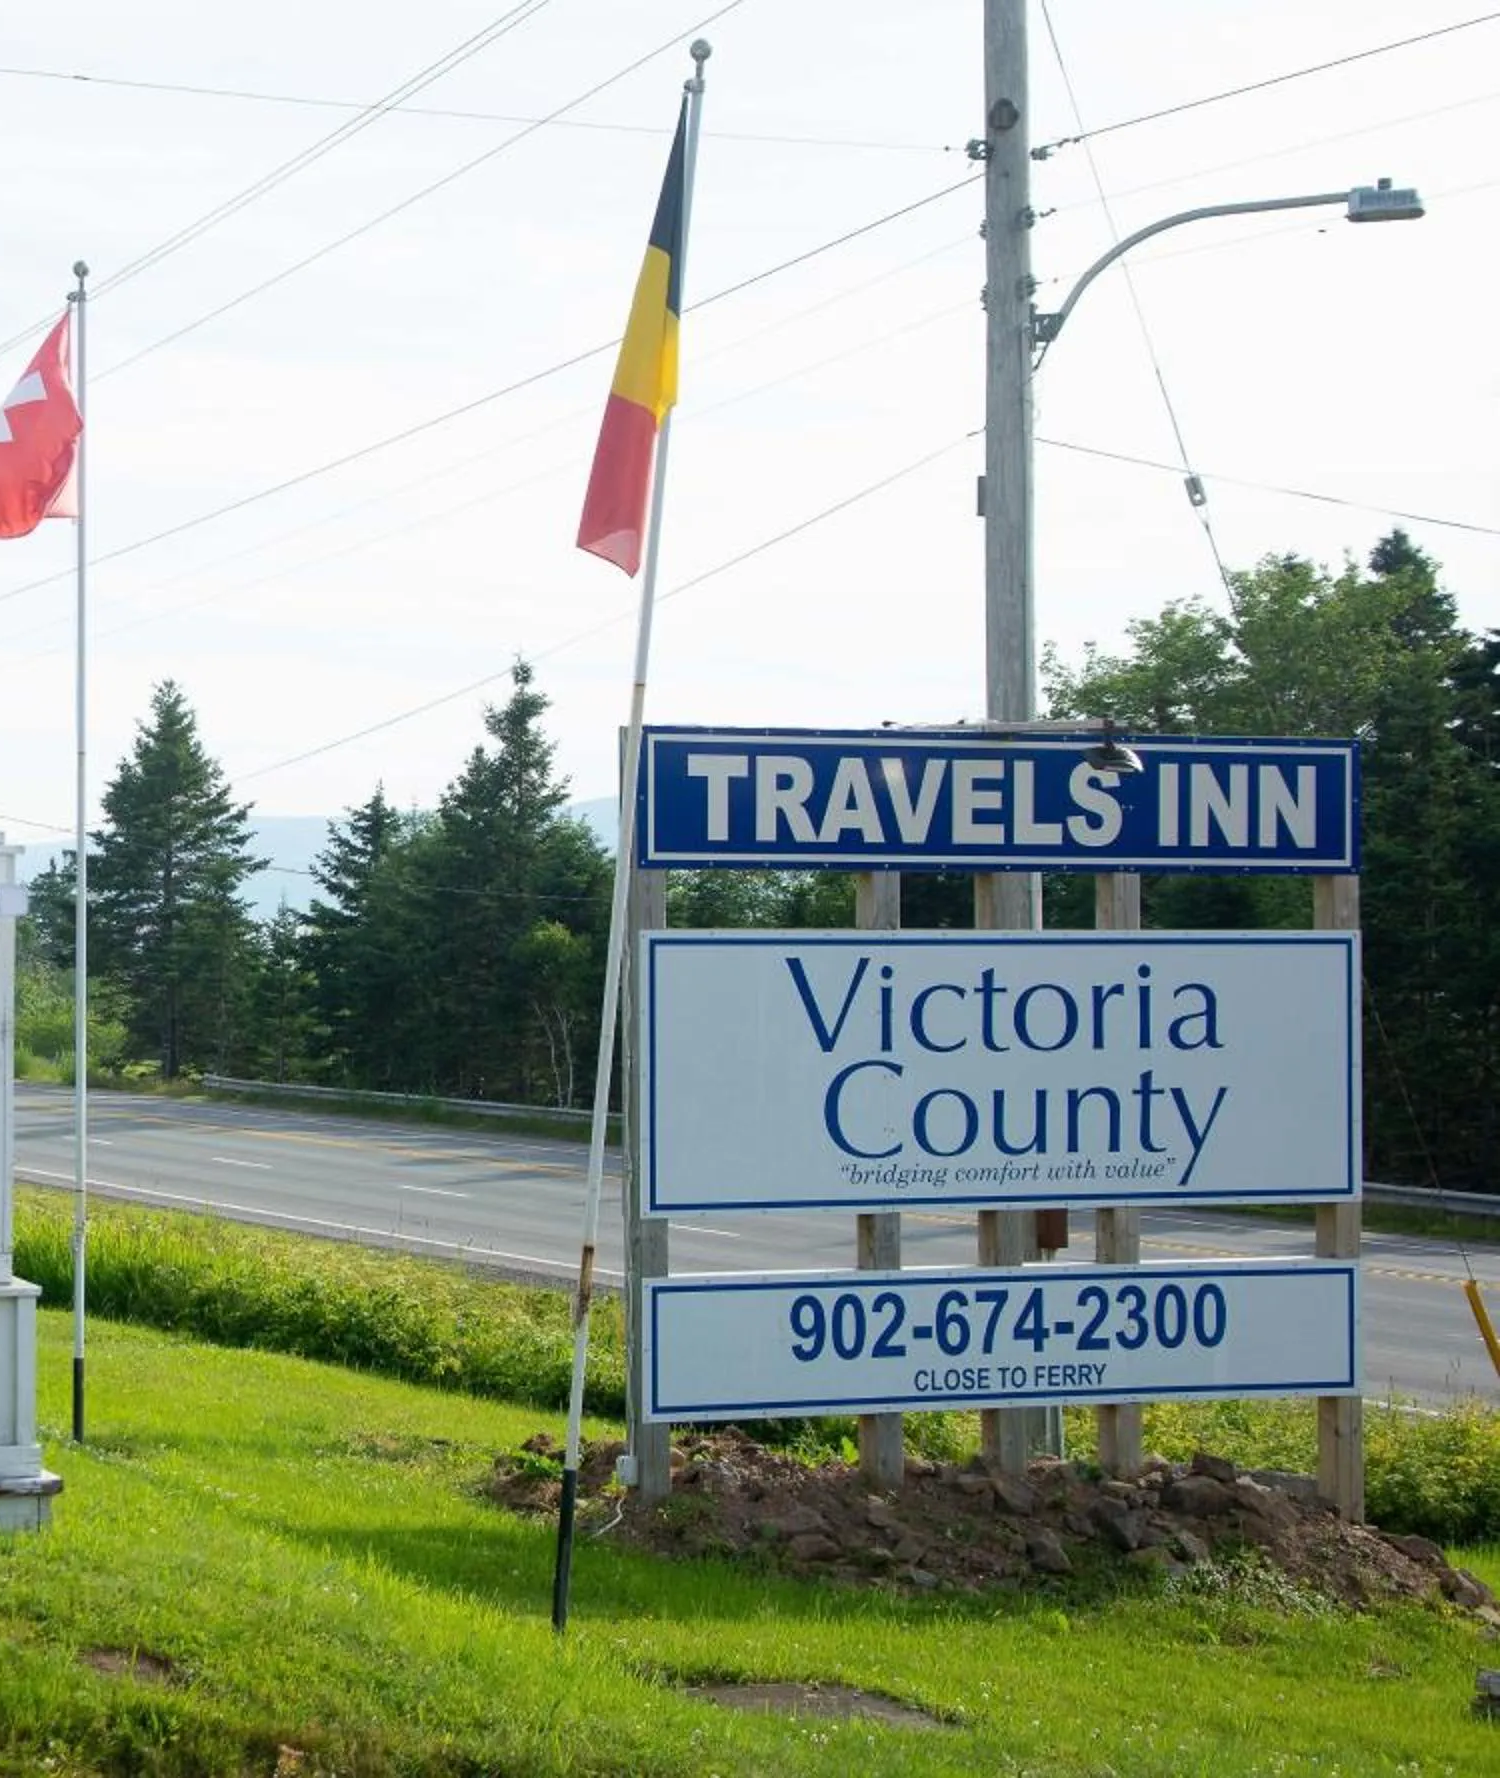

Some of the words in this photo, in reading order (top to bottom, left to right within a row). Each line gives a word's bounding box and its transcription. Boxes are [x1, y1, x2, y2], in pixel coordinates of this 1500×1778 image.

[687, 754, 1121, 847] TRAVELS
[1159, 764, 1316, 848] INN
[785, 957, 1225, 1053] Victoria
[823, 1060, 1228, 1186] County
[954, 1161, 1040, 1186] comfort
[1047, 1159, 1096, 1181] with
[789, 1283, 1227, 1362] 902-674-2300
[913, 1367, 991, 1393] CLOSE
[997, 1365, 1028, 1390] TO
[1033, 1362, 1108, 1389] FERRY
